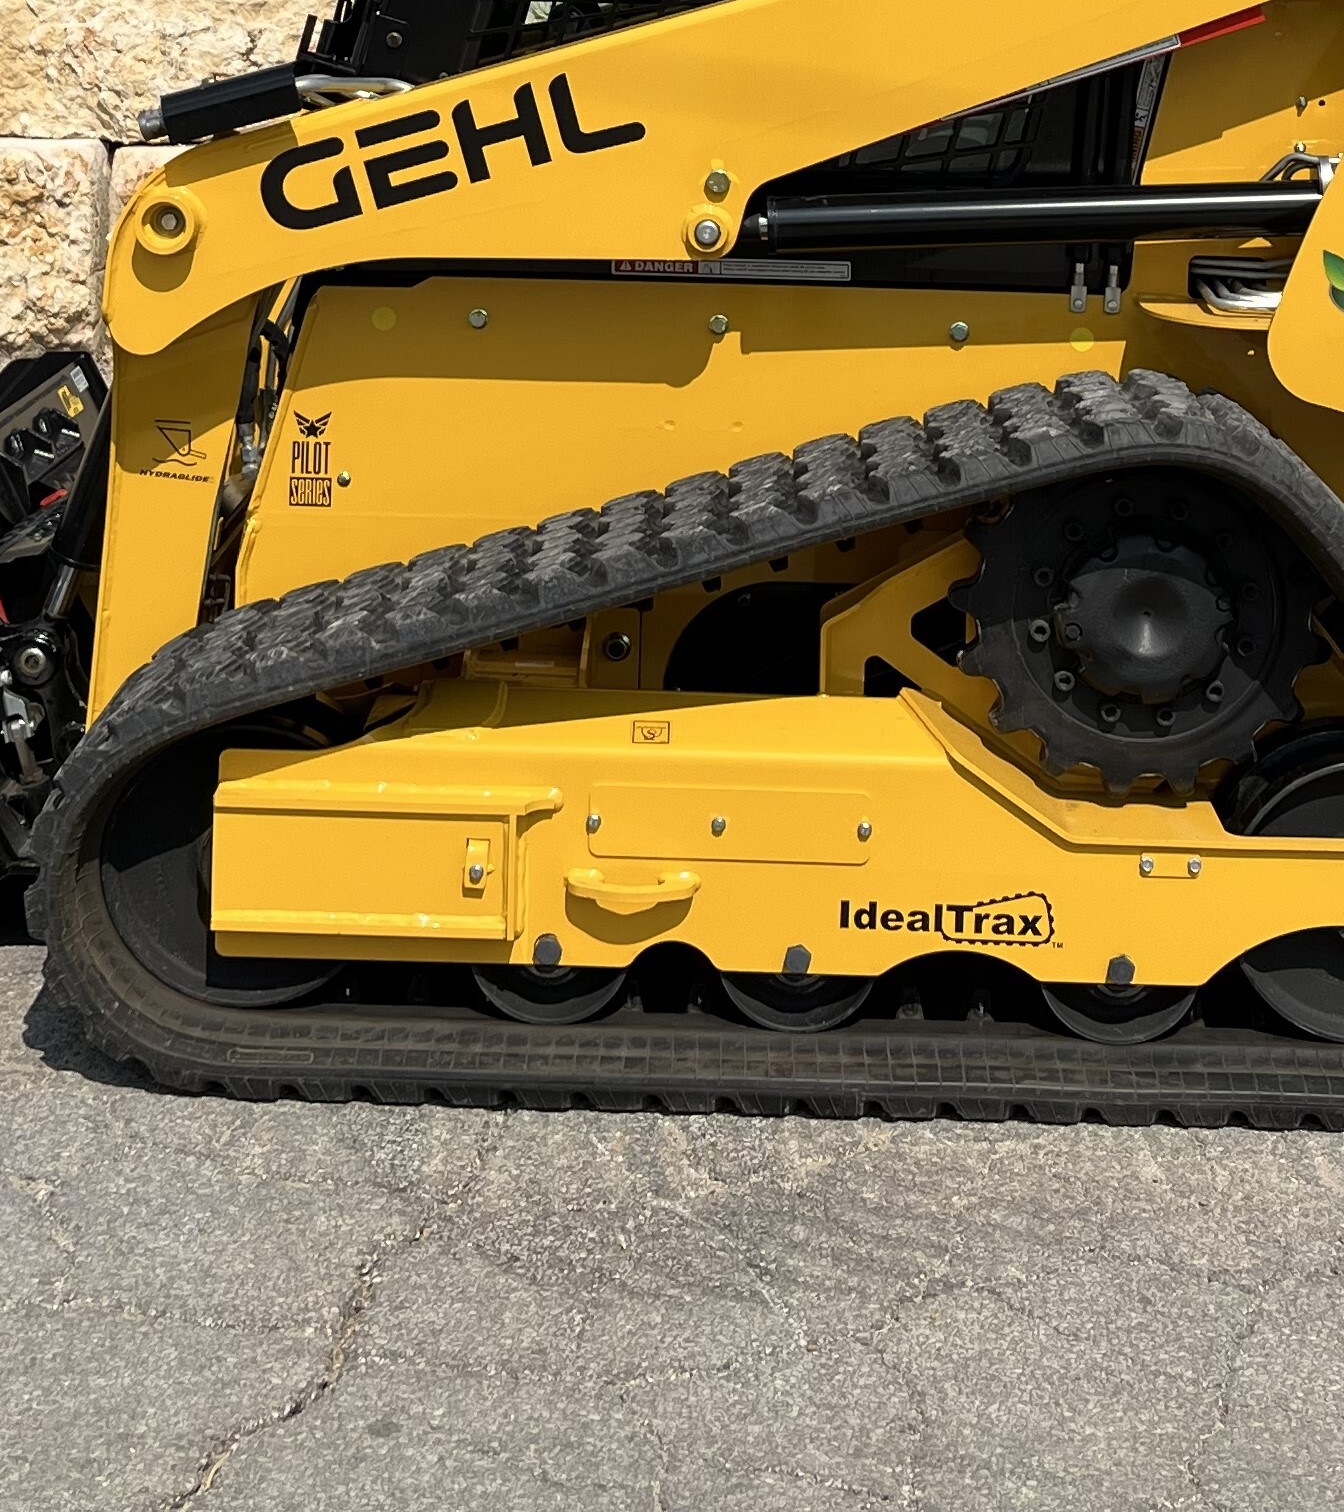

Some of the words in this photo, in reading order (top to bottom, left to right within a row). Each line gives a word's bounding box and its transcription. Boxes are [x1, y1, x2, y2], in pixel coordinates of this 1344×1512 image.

[260, 73, 646, 230] GEHL
[634, 260, 693, 273] DANGER
[291, 441, 331, 475] PILOT
[140, 469, 210, 482] HYDRAGLIDE
[840, 899, 1043, 937] IdealTrax
